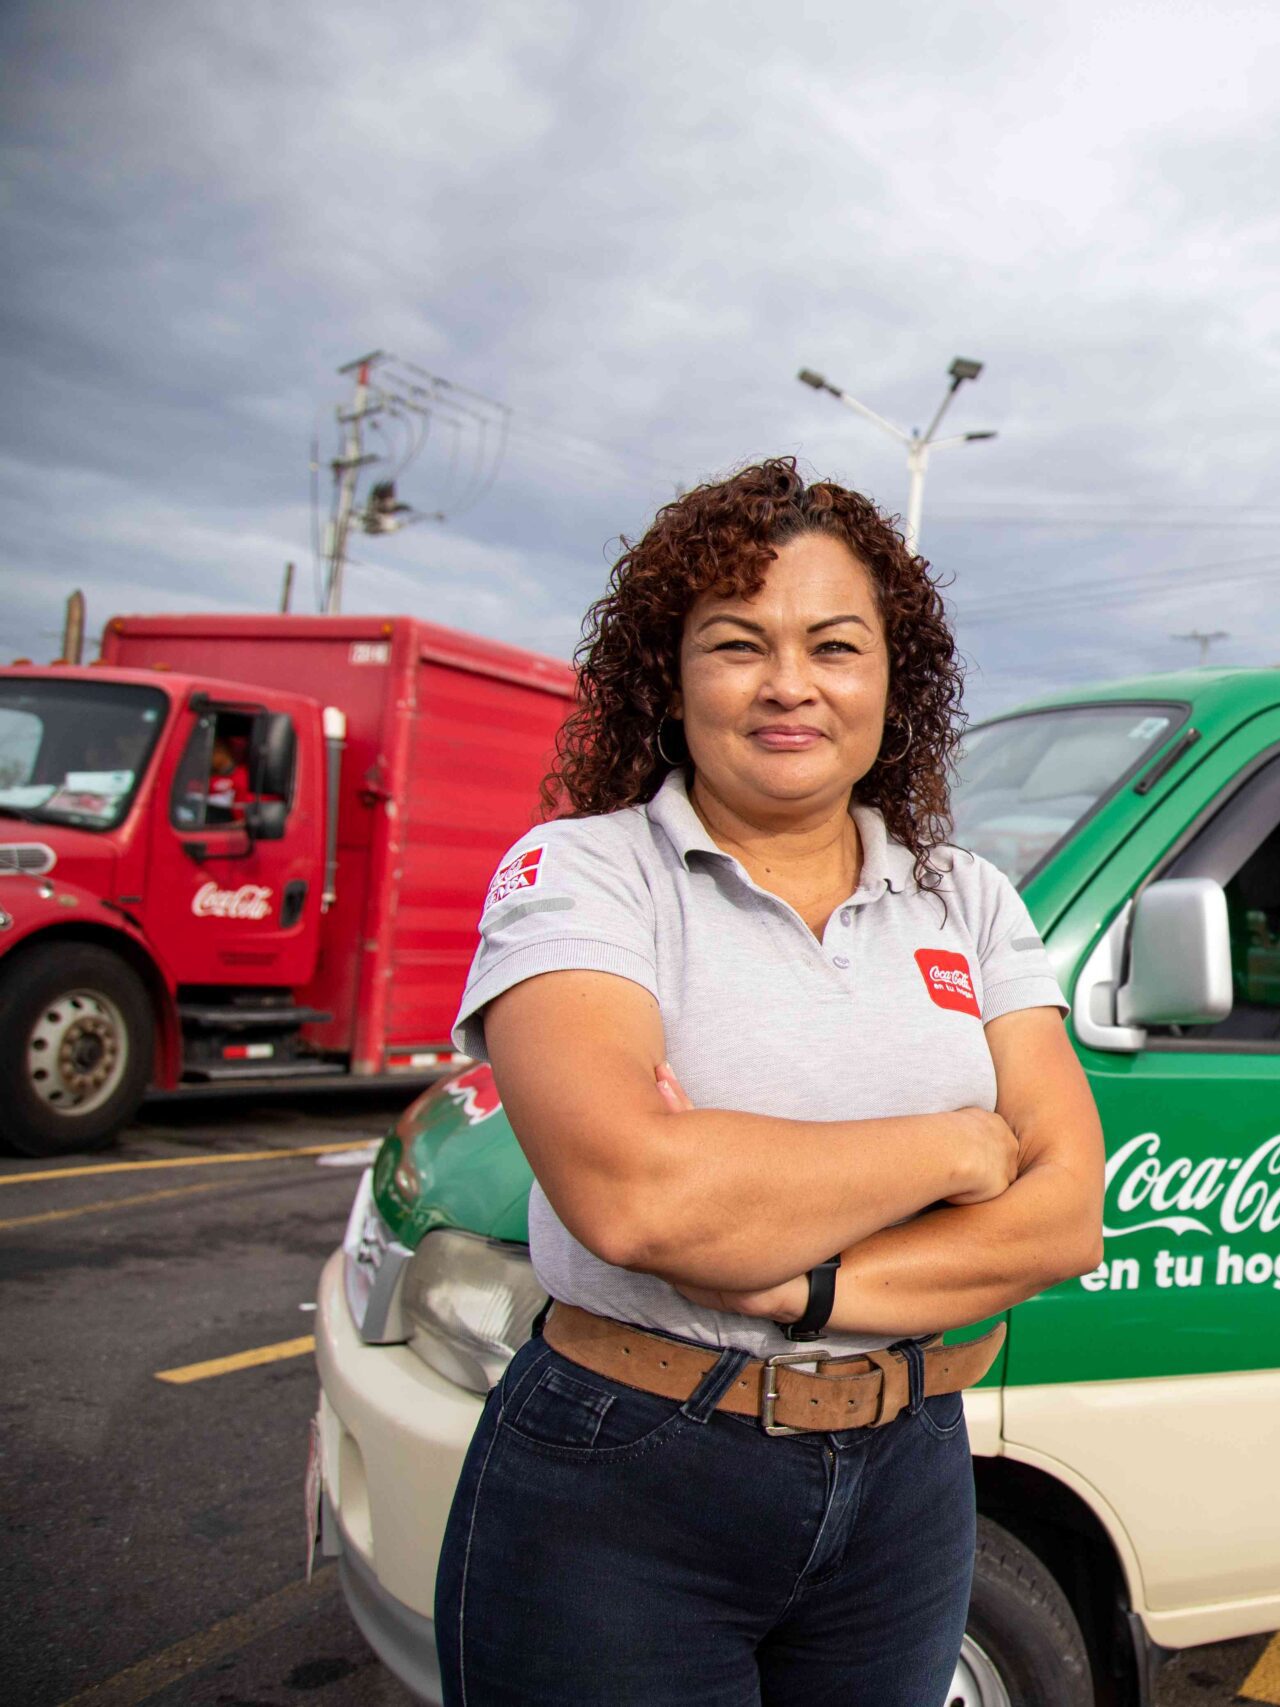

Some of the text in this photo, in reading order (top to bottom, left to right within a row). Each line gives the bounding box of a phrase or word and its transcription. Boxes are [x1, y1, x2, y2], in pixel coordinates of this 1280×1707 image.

[191, 881, 273, 920] Coca-Cola
[929, 965, 971, 991] Coca-Cola
[933, 983, 944, 991] en
[946, 983, 955, 993] tu
[1080, 1258, 1140, 1292] en
[1154, 1250, 1203, 1288] tu
